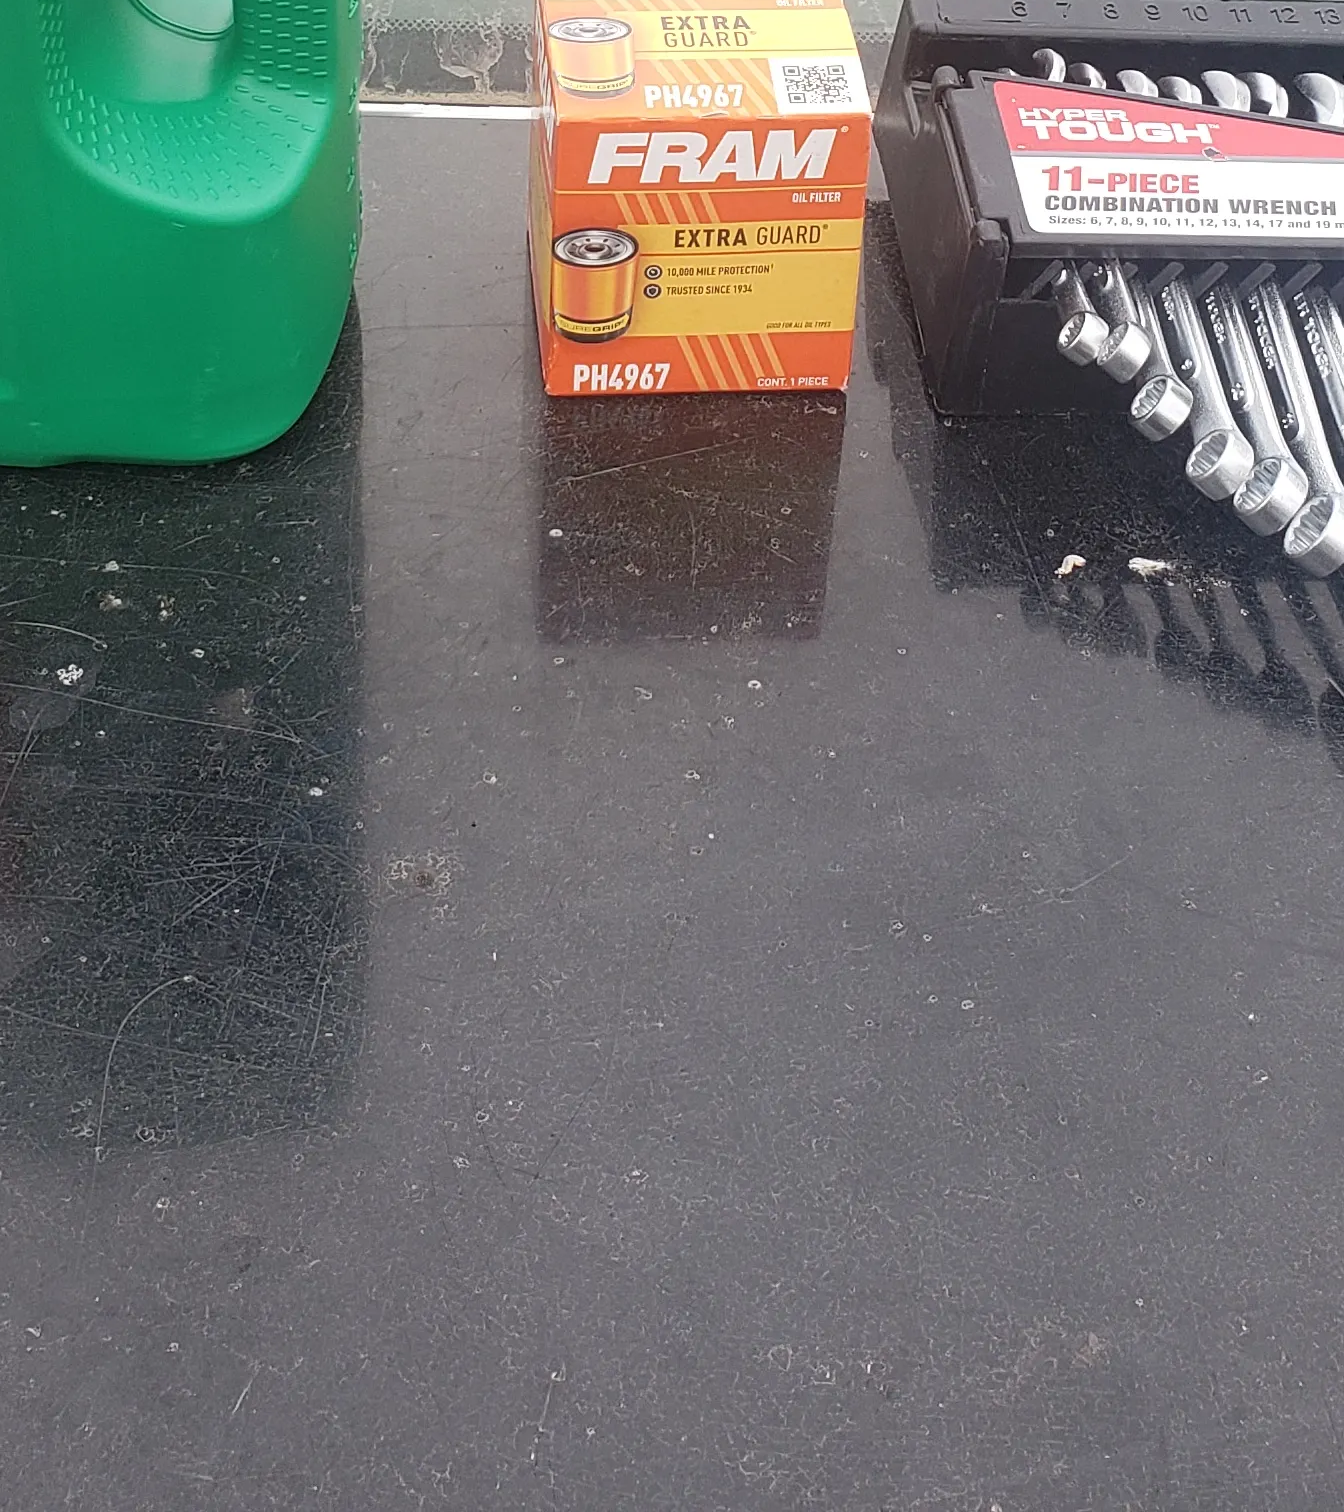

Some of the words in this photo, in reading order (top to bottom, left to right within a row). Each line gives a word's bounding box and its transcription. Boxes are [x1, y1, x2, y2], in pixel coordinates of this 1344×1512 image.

[660, 15, 751, 31] EXTRA
[1011, 1, 1028, 17] 6
[1055, 2, 1072, 19] 7
[1143, 4, 1161, 21] 9
[1182, 5, 1209, 22] 10
[1229, 8, 1253, 23] 11
[1270, 8, 1300, 24] 12
[1314, 8, 1342, 25] 13
[663, 31, 749, 48] GUARD
[644, 83, 744, 109] PH4967
[1017, 107, 1130, 123] HYPER
[1021, 119, 1214, 144] TOUGH
[587, 128, 838, 185] FRAM
[1042, 165, 1200, 194] 11-PIECE
[792, 192, 808, 203] OIL
[809, 191, 842, 203] FILTER
[1044, 195, 1219, 214] COMBINATION
[1228, 199, 1338, 216] WRENCH
[1048, 215, 1086, 225] Sizes:
[1090, 217, 1102, 226] 6,
[1106, 217, 1117, 226] 7,
[1121, 217, 1133, 227] 8,
[1136, 217, 1148, 227] 9,
[1153, 217, 1172, 228] 10,
[1175, 218, 1195, 228] 11,
[1199, 218, 1218, 228] 12,
[1222, 218, 1241, 229] 13,
[1245, 219, 1265, 229] 14,
[1268, 219, 1284, 228] 17
[1287, 219, 1311, 229] and
[1315, 220, 1331, 229] 19
[674, 227, 748, 248] EXTRA
[756, 224, 822, 245] GUARD
[667, 267, 695, 278] 10,000
[696, 266, 716, 276] MILE
[666, 286, 704, 296] TRUSTED
[705, 285, 731, 295] SINCE
[733, 284, 753, 294] 1934
[1303, 316, 1333, 379] TOUGH
[573, 362, 671, 392] PH4967
[757, 376, 788, 388] CONT.
[790, 377, 796, 387] 1
[797, 376, 829, 387] PIECE
